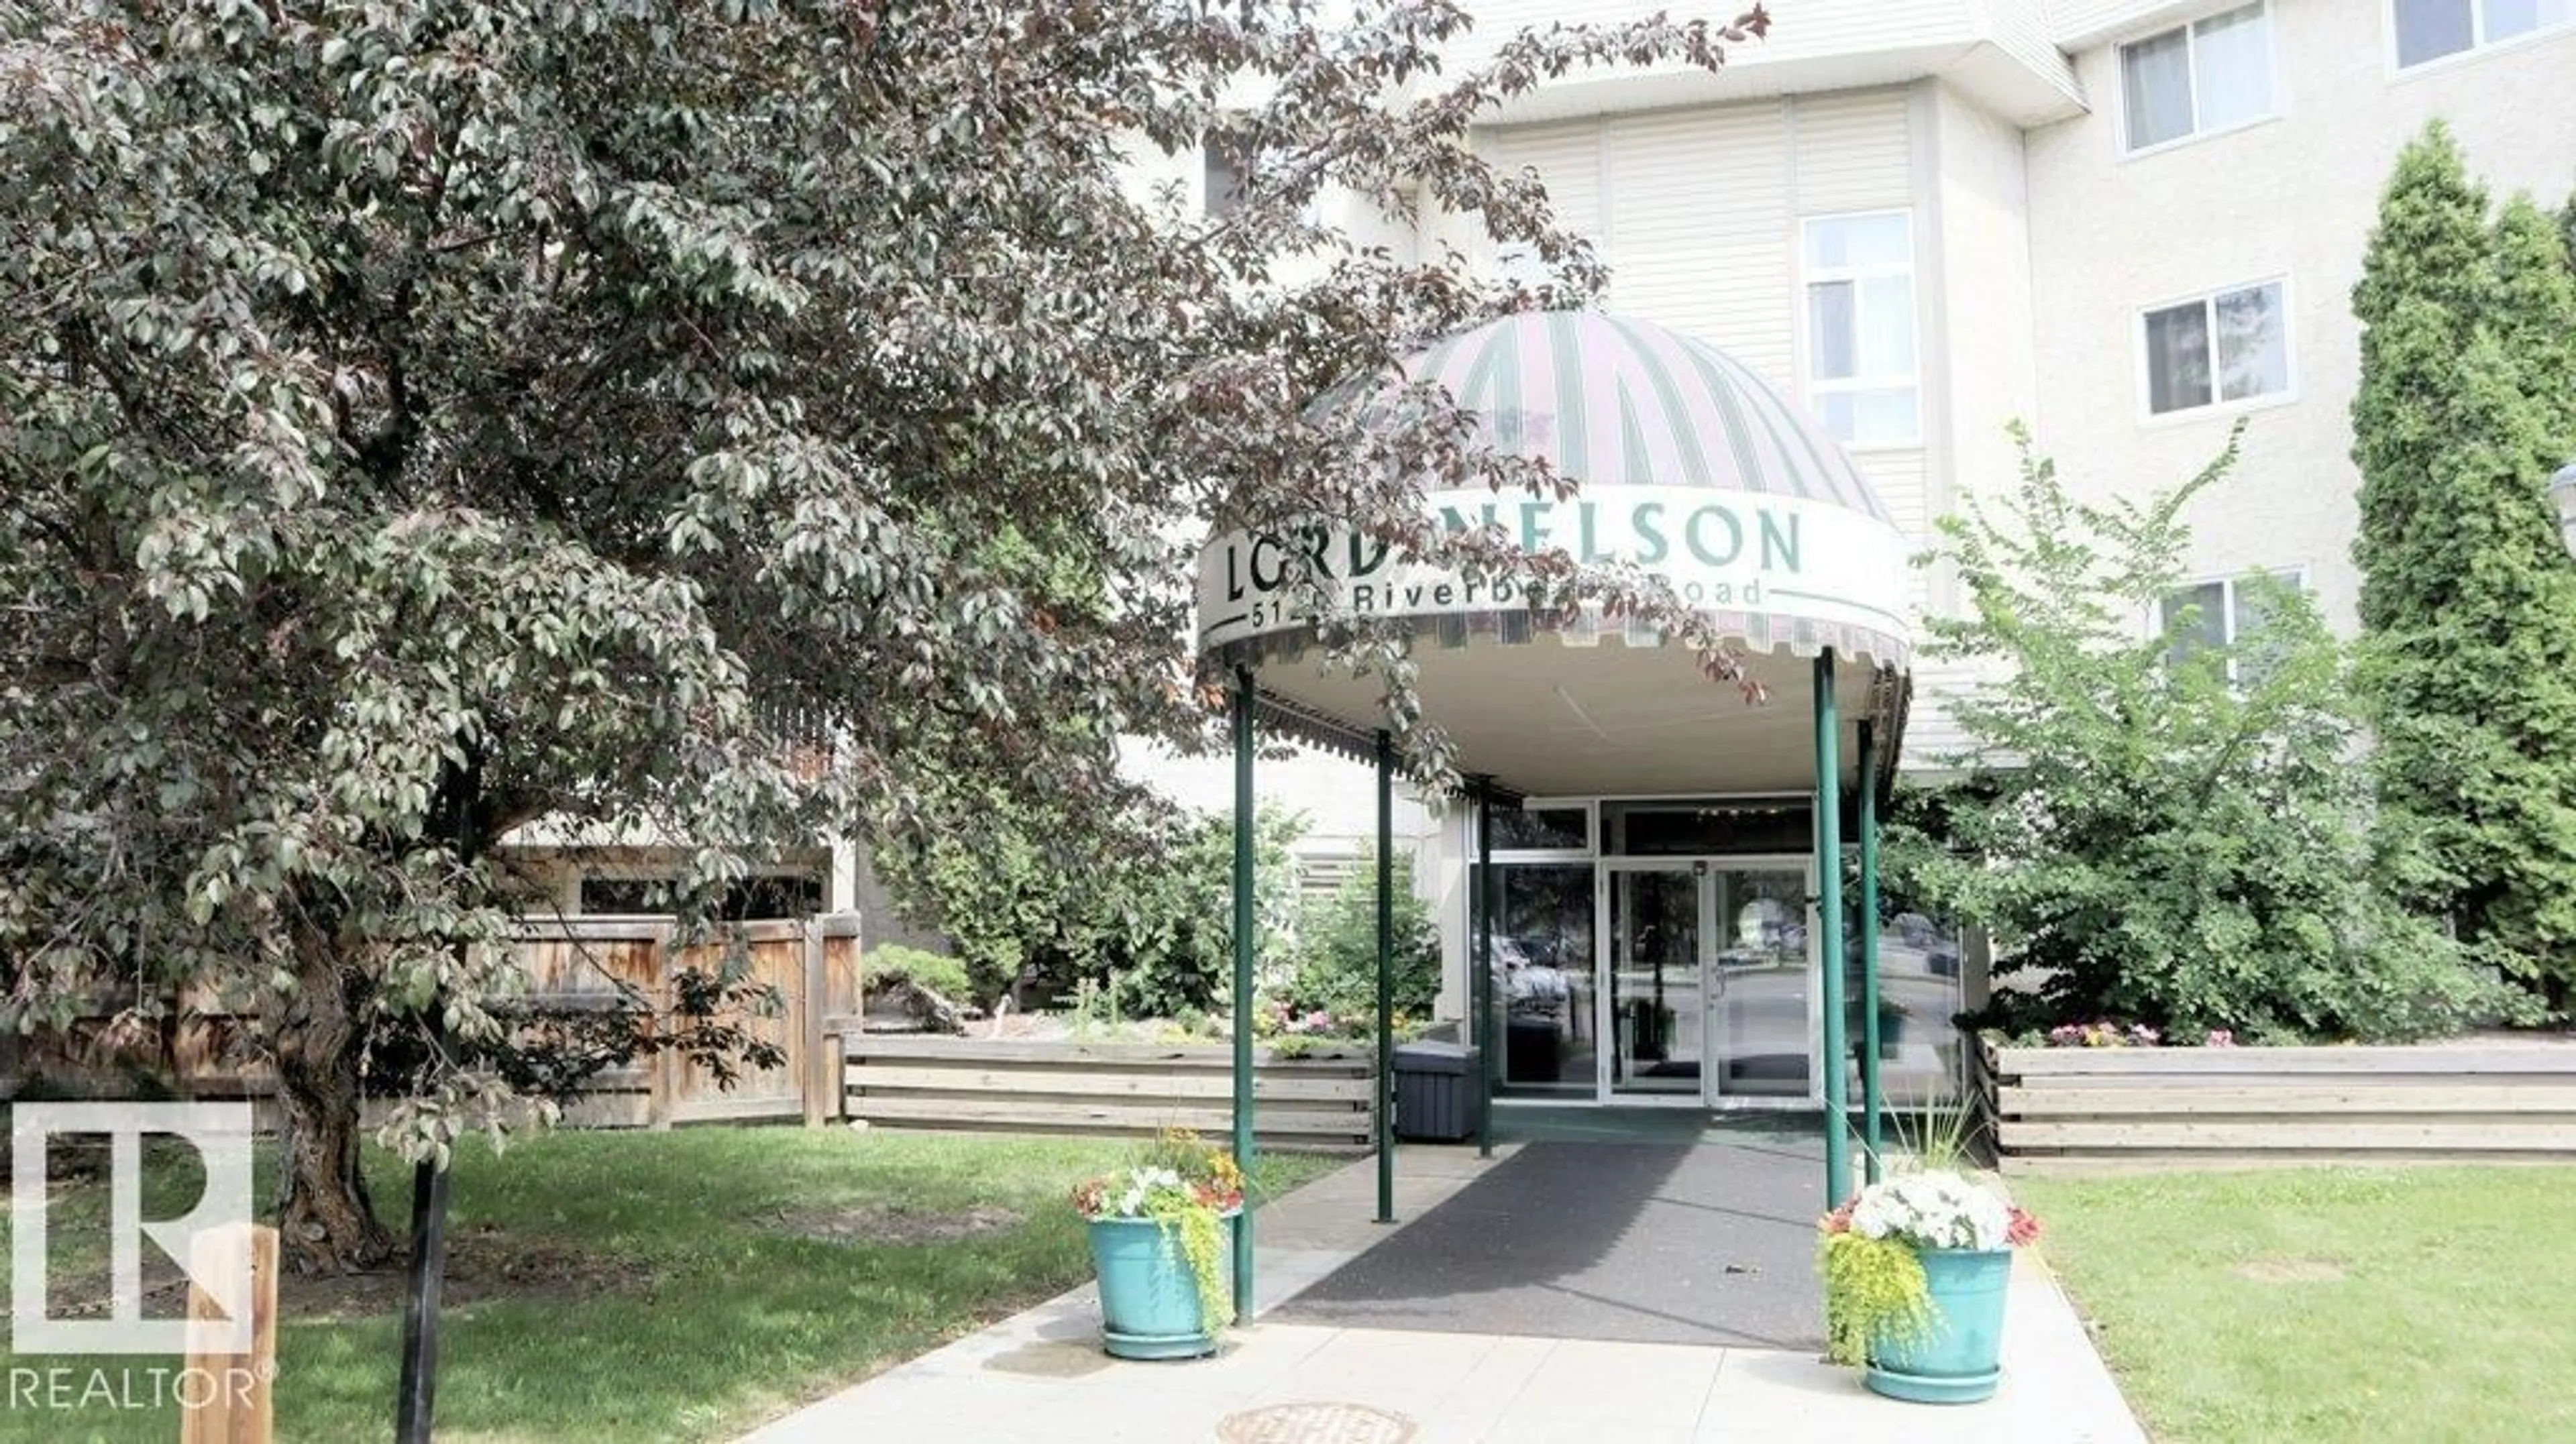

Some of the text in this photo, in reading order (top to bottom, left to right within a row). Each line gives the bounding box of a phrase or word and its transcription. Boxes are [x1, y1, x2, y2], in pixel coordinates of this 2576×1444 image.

[1228, 525, 1387, 601] LORD
[1252, 573, 1760, 627] 51 Riverb oad
